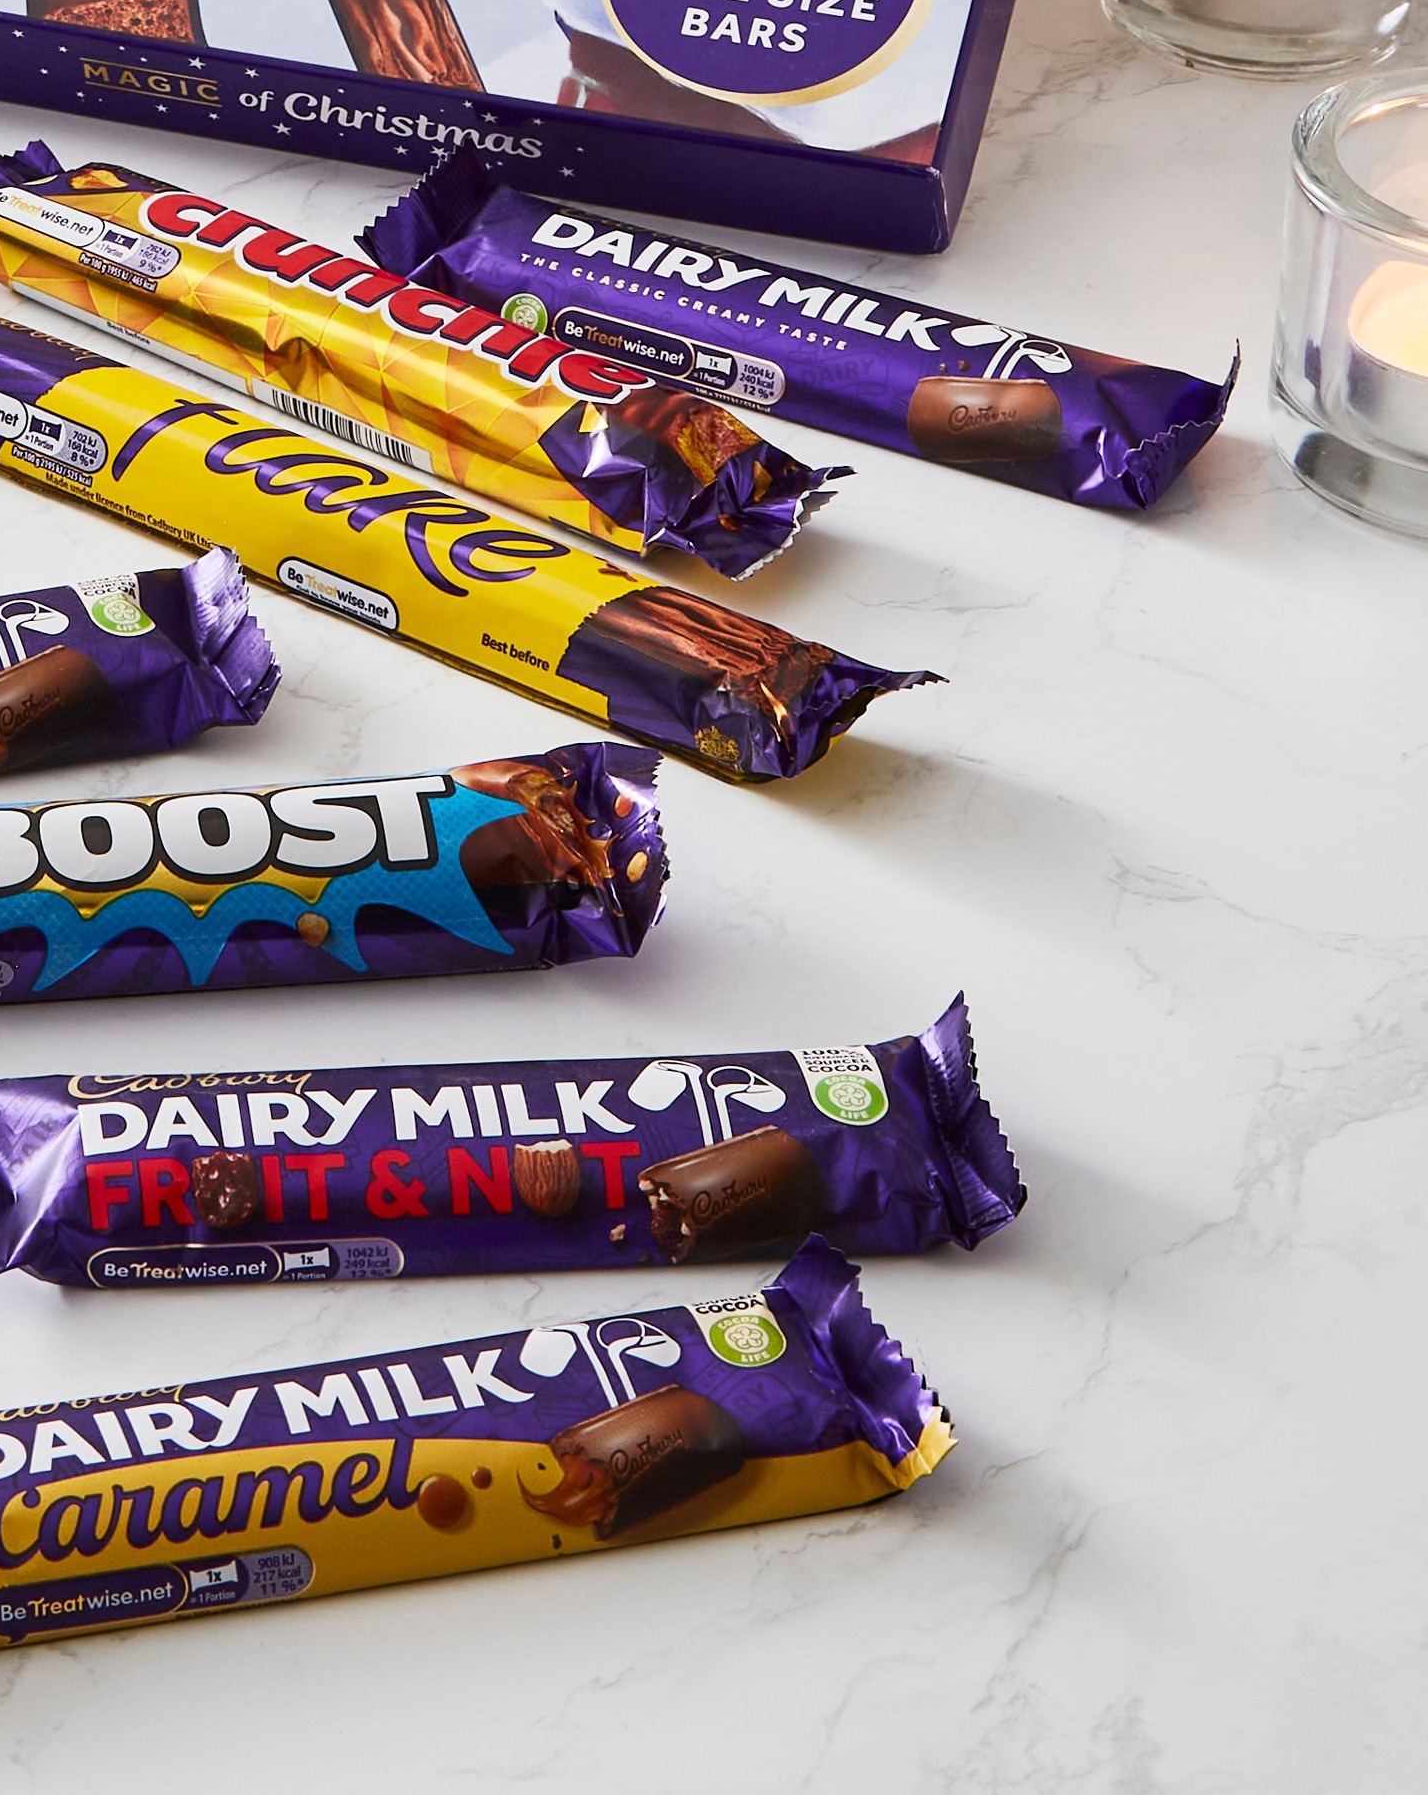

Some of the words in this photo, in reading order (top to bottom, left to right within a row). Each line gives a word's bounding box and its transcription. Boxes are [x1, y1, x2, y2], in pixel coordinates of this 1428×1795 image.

[680, 6, 808, 54] BARS
[83, 61, 220, 103] MAGIC
[239, 90, 274, 124] of
[283, 92, 543, 160] Christmas
[531, 214, 773, 291] DAIRY
[757, 276, 950, 351] MILK
[520, 252, 559, 272] THE
[571, 267, 665, 302] CLASSIC
[677, 296, 766, 329] CREAMY
[779, 324, 848, 351] TASTE
[708, 357, 720, 370] 1x
[743, 363, 764, 378] 1004
[743, 384, 756, 397] 12
[46, 472, 68, 490] Made
[70, 484, 96, 502] under
[125, 505, 147, 523] from
[147, 515, 182, 539] Cadbury
[183, 527, 196, 544] UK
[481, 632, 508, 656] Best
[509, 641, 551, 673] before
[807, 1064, 873, 1073] COCOA
[77, 1088, 378, 1156] DAIRY
[390, 1078, 636, 1142] MILK
[839, 1110, 870, 1120] LIFE
[364, 1148, 430, 1220] &
[300, 1254, 314, 1266] 1x
[695, 1299, 764, 1314] COCOA
[740, 1351, 771, 1363] LIFE
[274, 1347, 535, 1435] MILK
[608, 1425, 685, 1487] Cadbury
[258, 1556, 281, 1569] 908
[206, 1570, 222, 1584] 1x
[254, 1569, 277, 1582] 217
[278, 1564, 301, 1579] kcal
[206, 1590, 236, 1603] Portion
